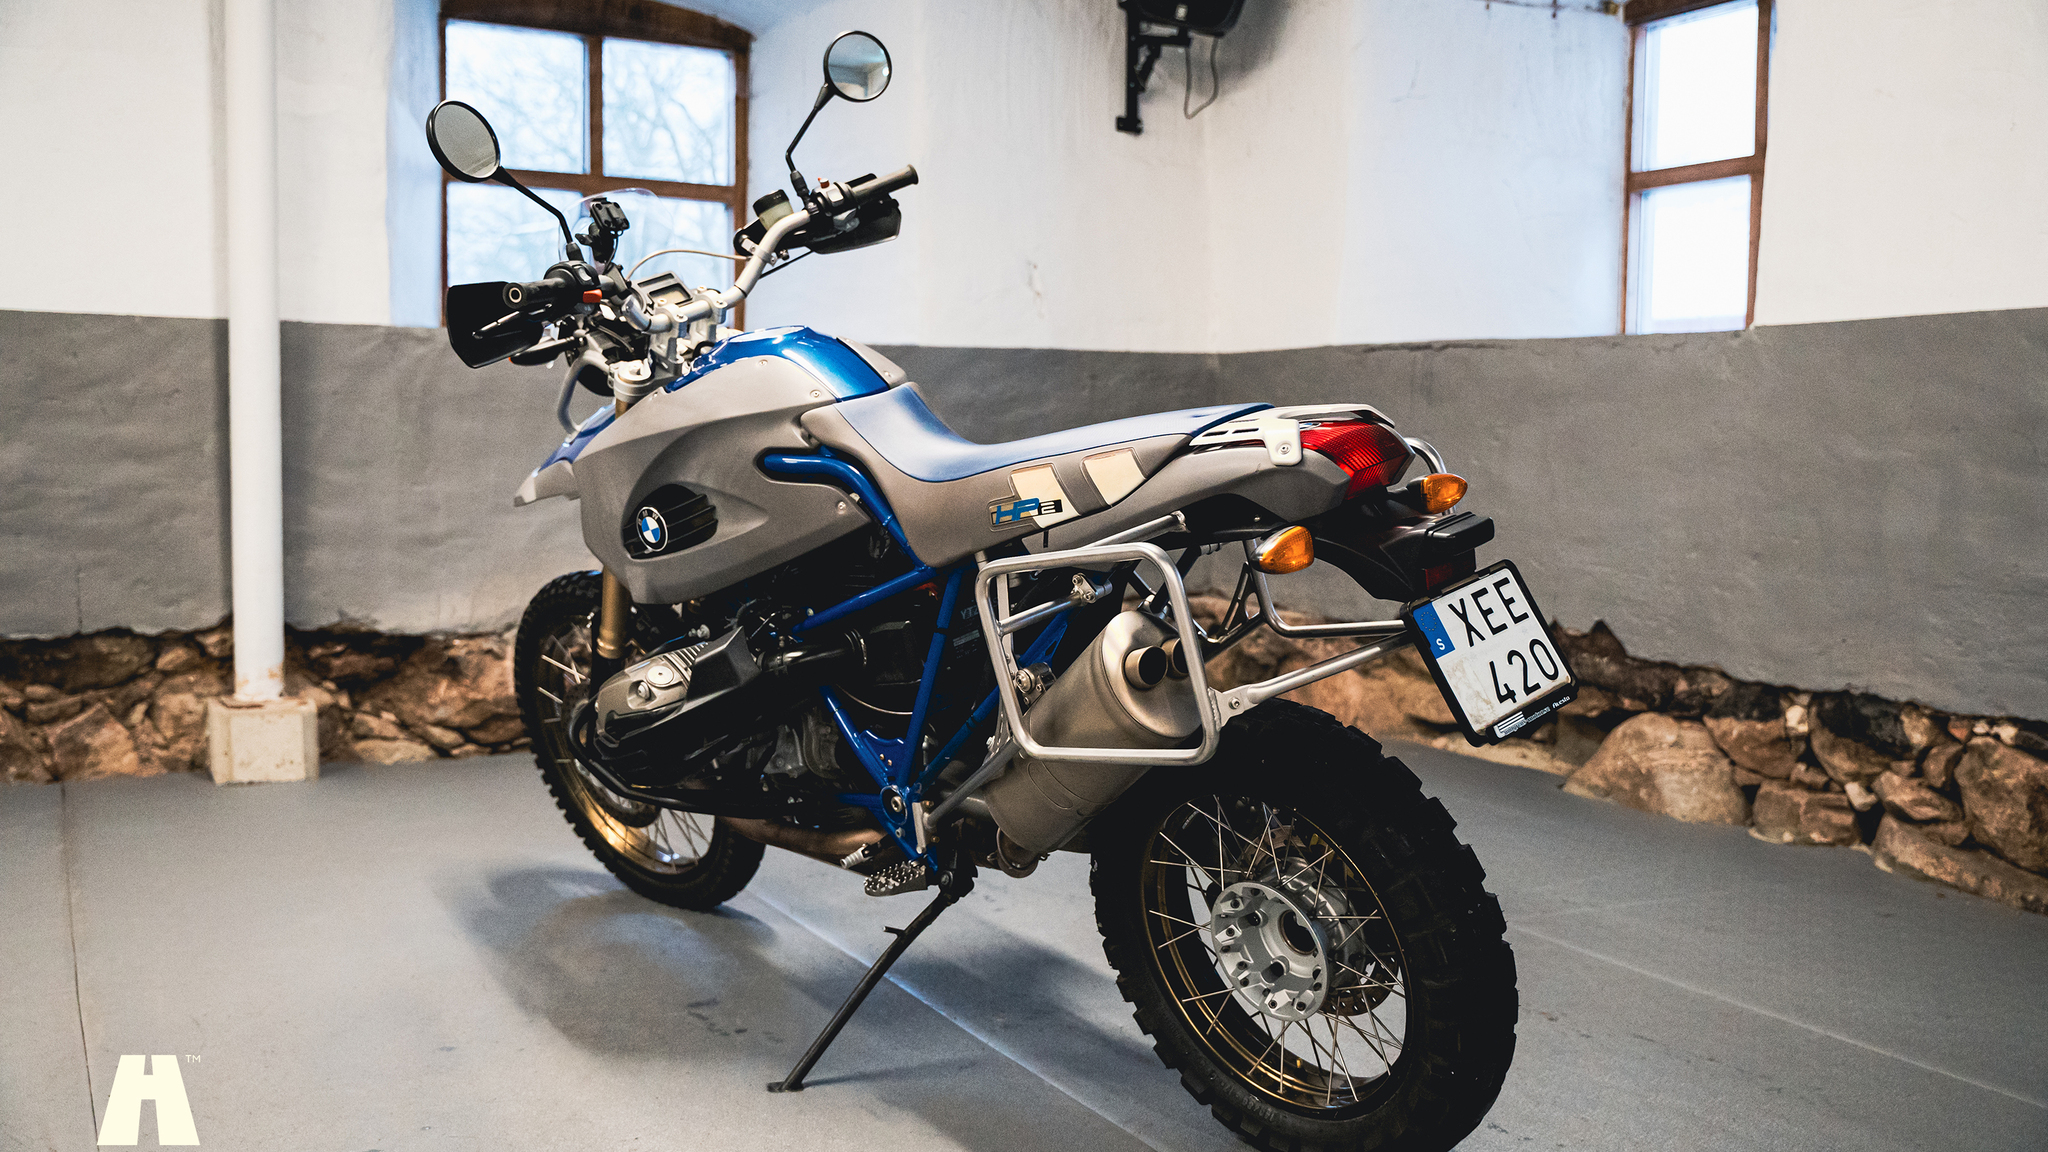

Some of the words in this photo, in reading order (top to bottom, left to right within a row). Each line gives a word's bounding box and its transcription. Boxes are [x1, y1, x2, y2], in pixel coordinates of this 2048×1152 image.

[995, 498, 1056, 525] HP2
[1447, 577, 1529, 648] XEE
[1436, 638, 1446, 650] S
[1489, 638, 1559, 704] 420
